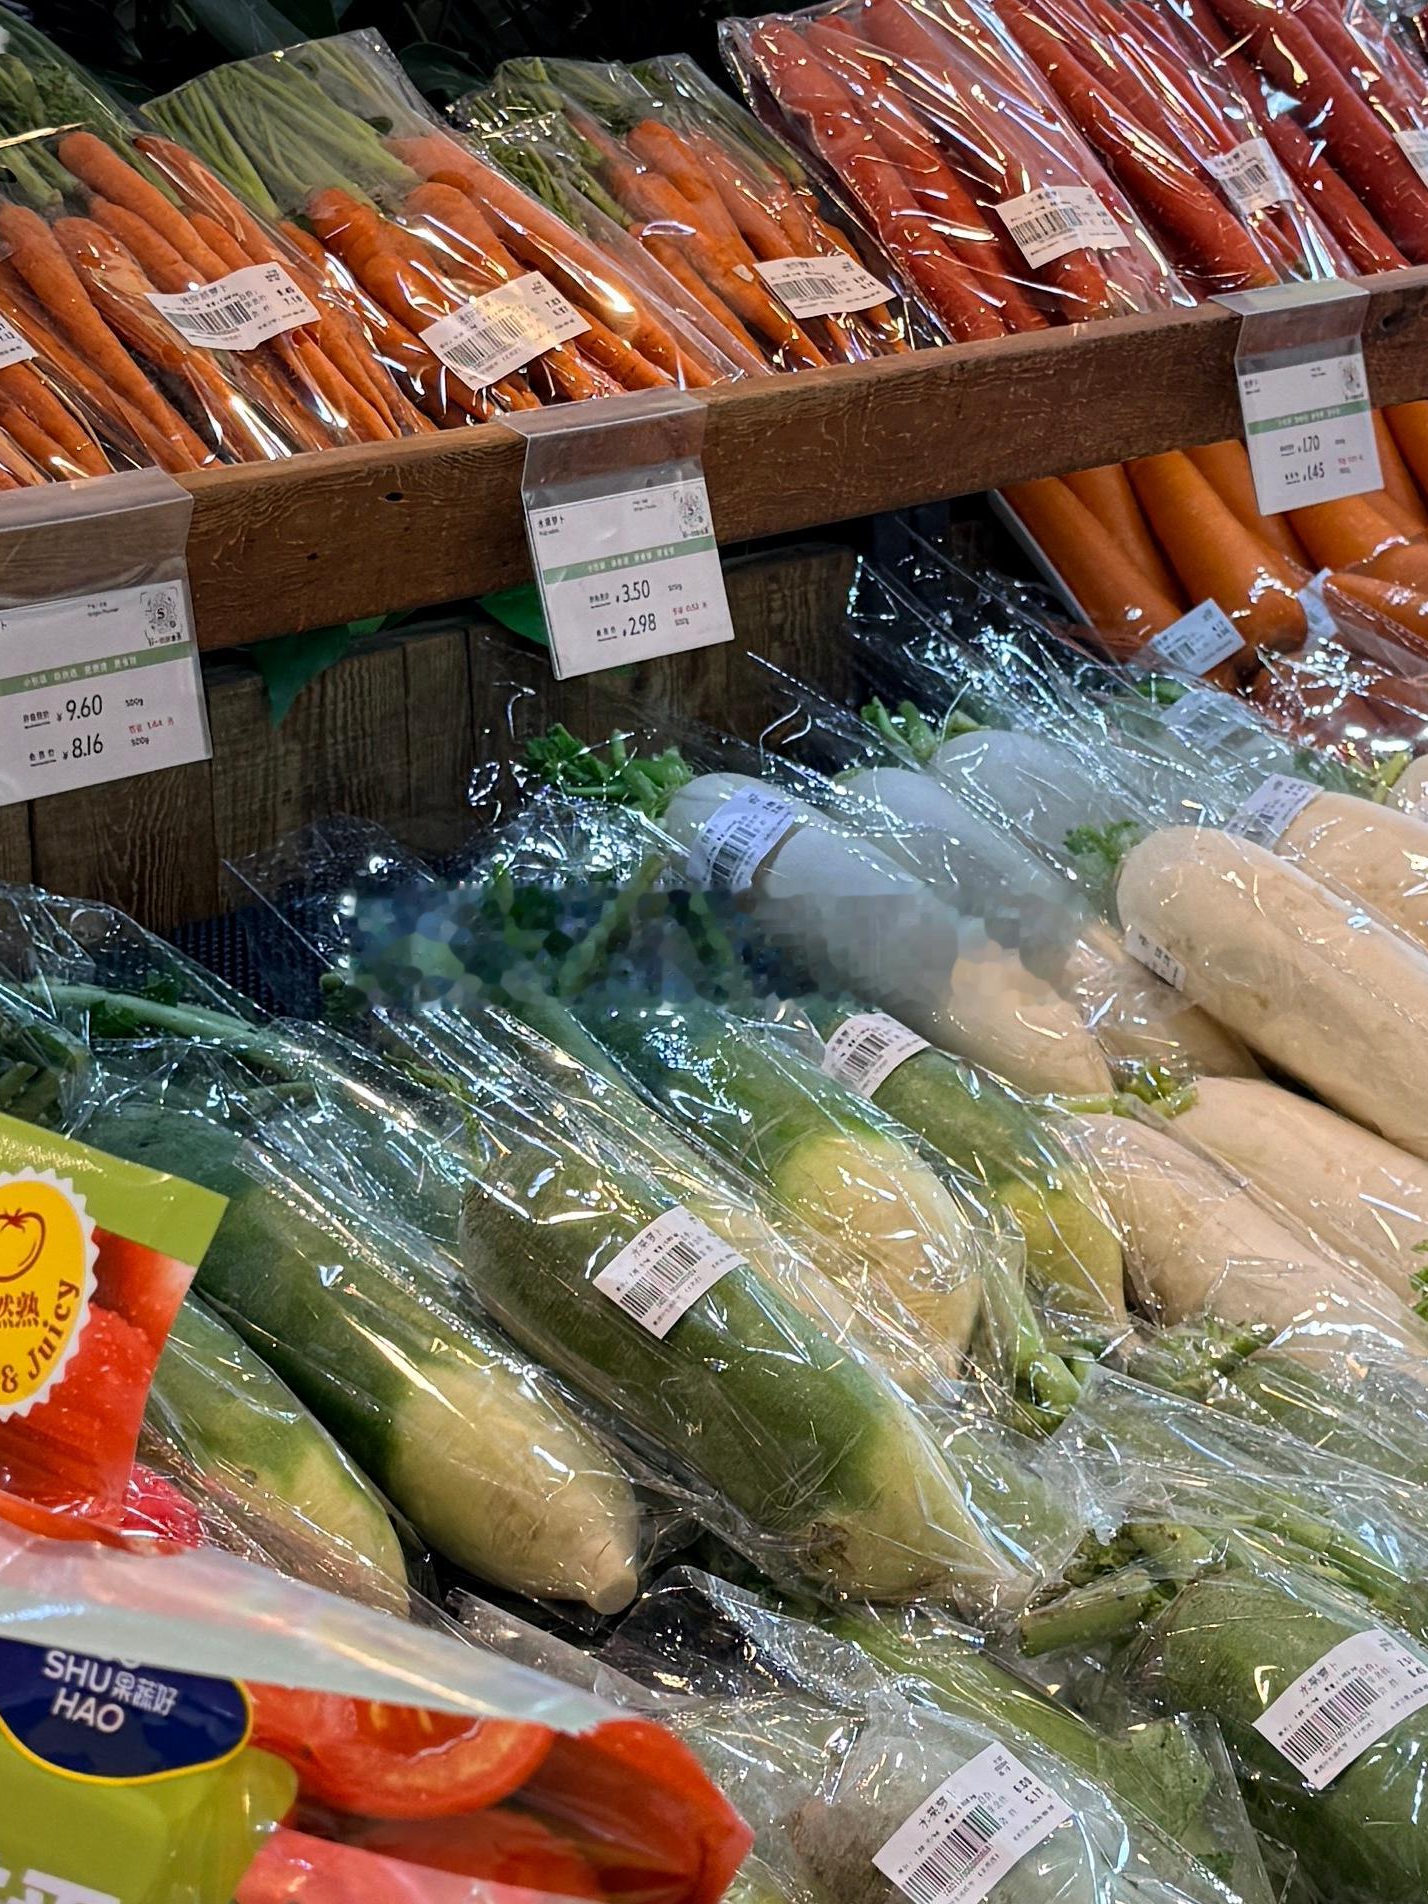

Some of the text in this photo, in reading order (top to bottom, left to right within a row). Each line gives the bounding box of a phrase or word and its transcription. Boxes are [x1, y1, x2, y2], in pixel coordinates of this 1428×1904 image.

[1, 1363, 19, 1394] &
[27, 1278, 81, 1382] Juicy
[43, 1649, 112, 1694] SHU
[51, 1688, 126, 1734] HAO
